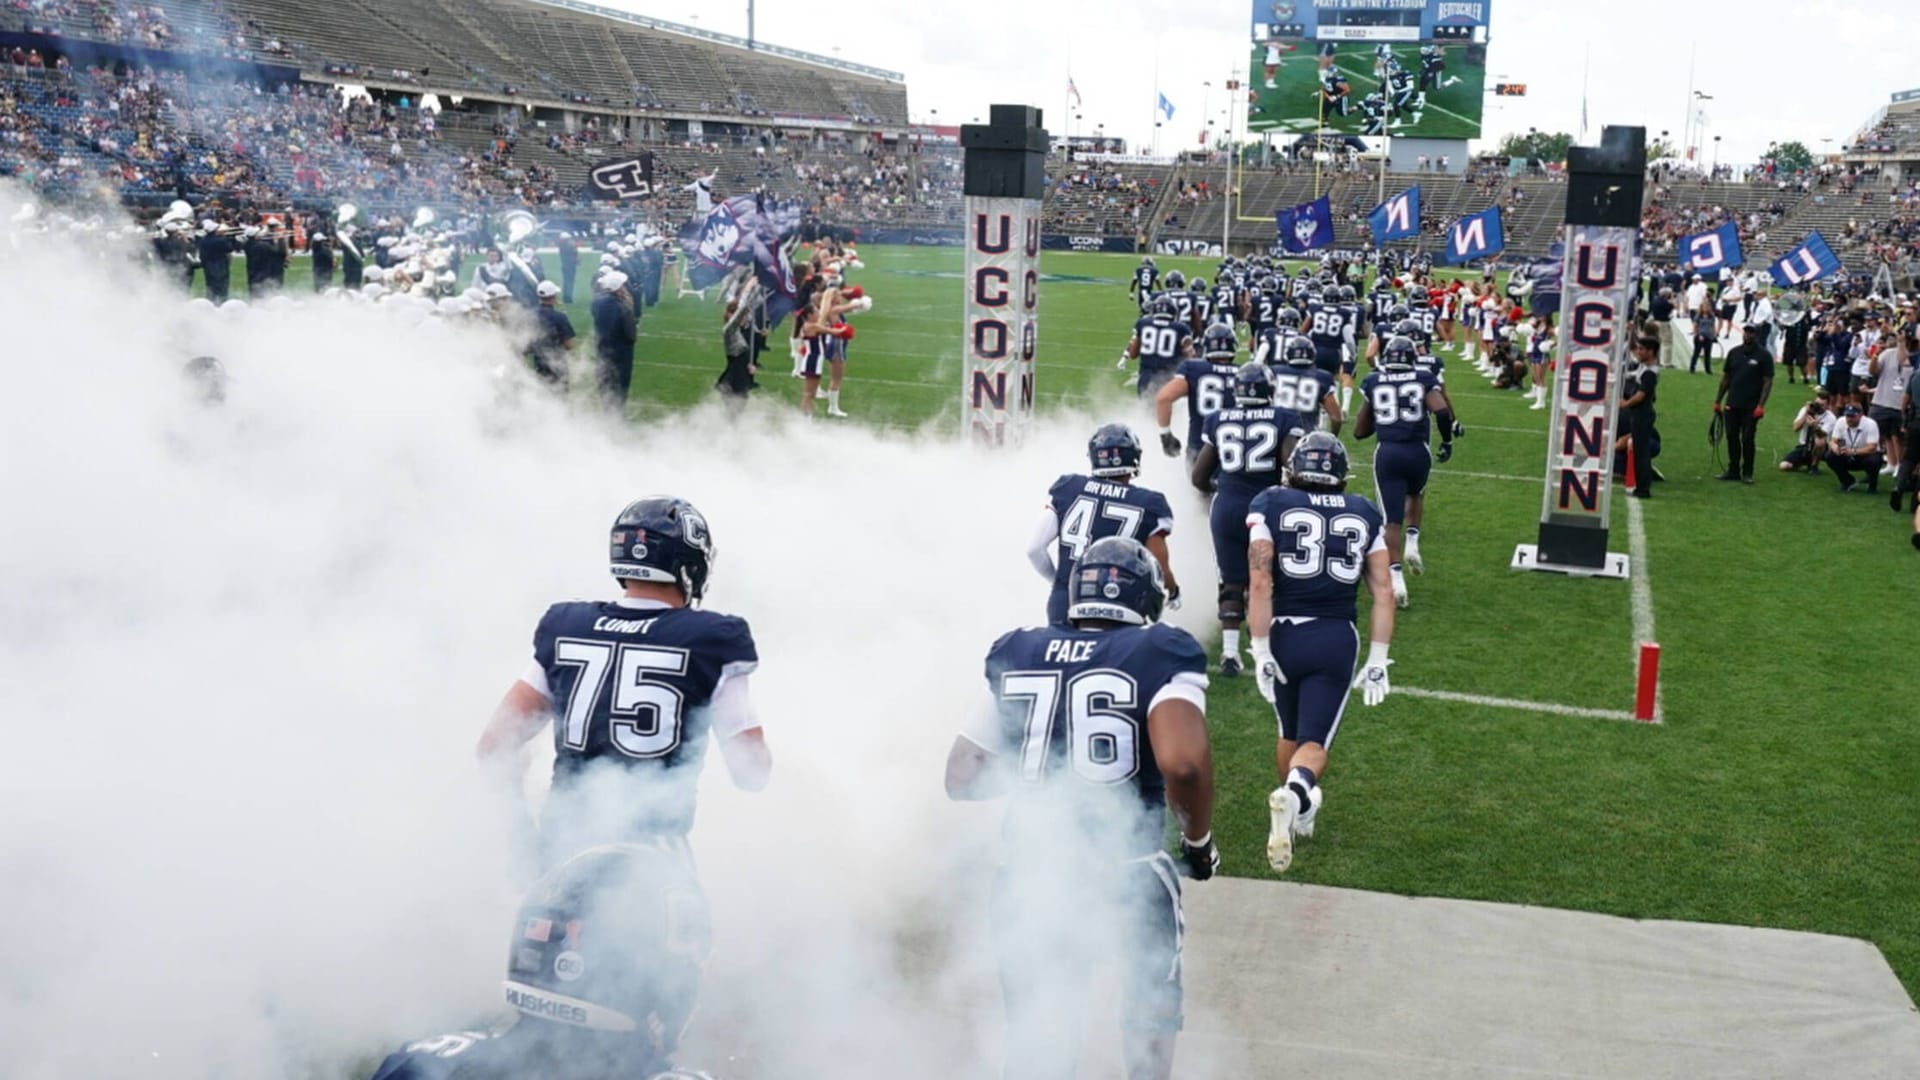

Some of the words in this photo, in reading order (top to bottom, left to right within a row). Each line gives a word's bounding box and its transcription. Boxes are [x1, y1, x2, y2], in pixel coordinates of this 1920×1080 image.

[1141, 272, 1151, 286] 9
[1217, 290, 1235, 308] 21
[1259, 302, 1273, 322] 2
[1313, 312, 1343, 337] 68
[1140, 326, 1177, 357] 90
[1273, 373, 1319, 411] 59
[1557, 244, 1618, 511] UCONN
[1373, 382, 1424, 425] 93
[1216, 421, 1278, 472] 62
[1084, 480, 1129, 499] BRYANT
[1308, 493, 1346, 507] WEBB
[1061, 495, 1144, 561] 47
[1278, 507, 1370, 584] 33
[593, 616, 659, 634] LUNDT
[1076, 607, 1124, 619] HUSKIES
[1045, 639, 1097, 663] PACE
[555, 637, 690, 758] 75
[1000, 668, 1140, 786] 76
[506, 988, 587, 1024] HUSKIES
